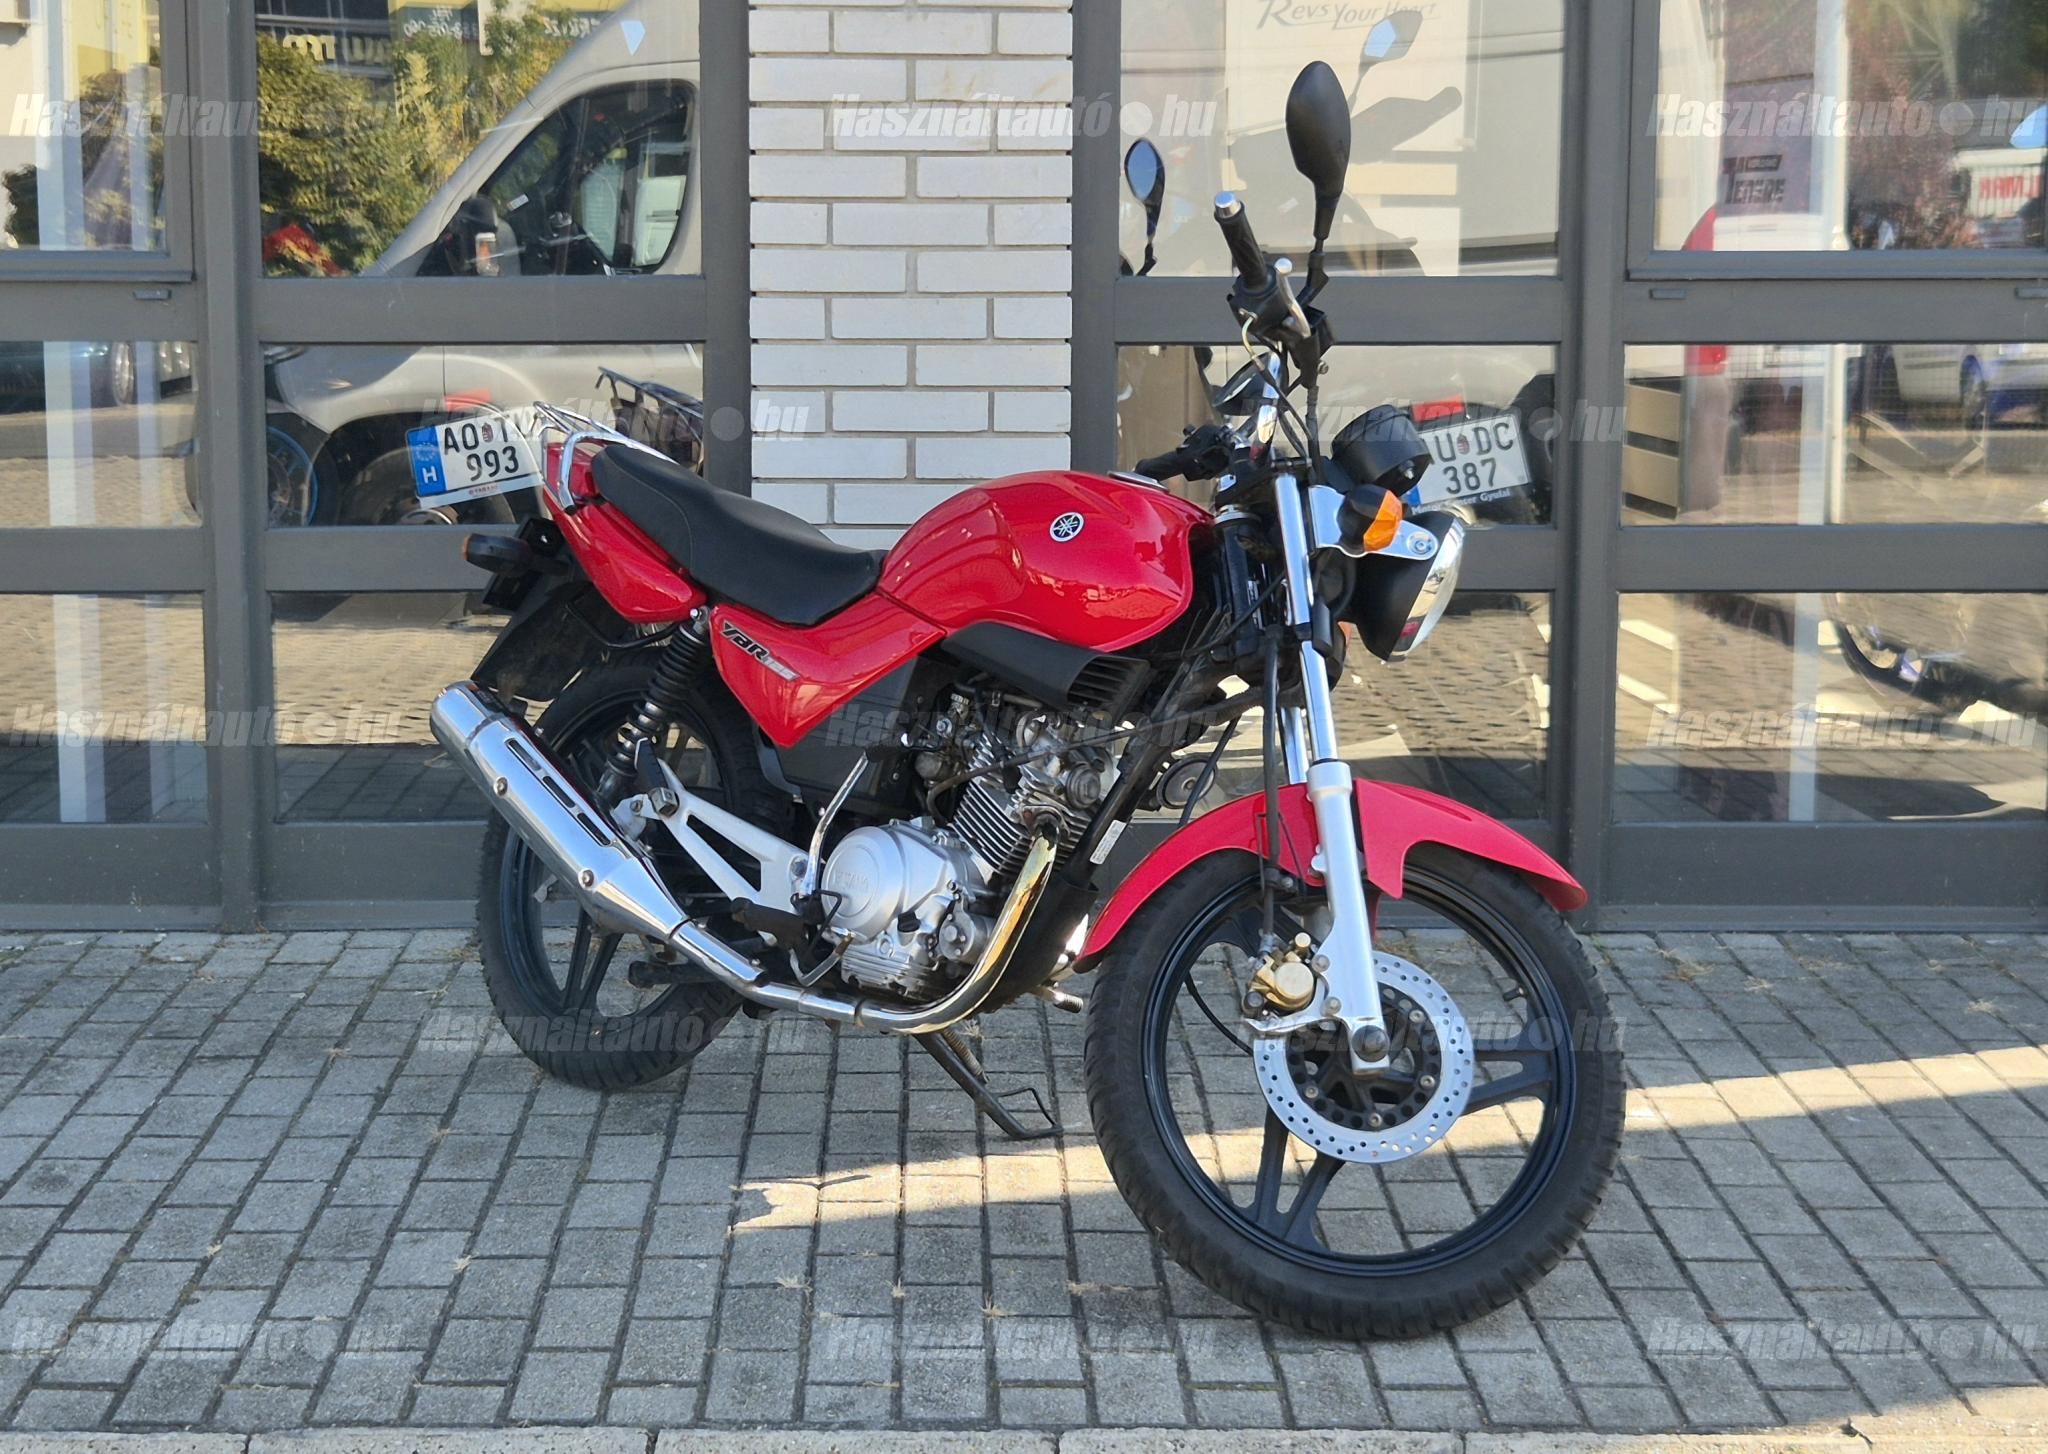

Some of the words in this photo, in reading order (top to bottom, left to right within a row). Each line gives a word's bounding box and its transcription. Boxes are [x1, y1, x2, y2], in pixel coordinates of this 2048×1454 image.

[444, 423, 480, 455] AO
[1471, 422, 1514, 456] DC
[422, 466, 438, 484] H
[466, 446, 519, 481] 993
[1443, 457, 1497, 494] 387
